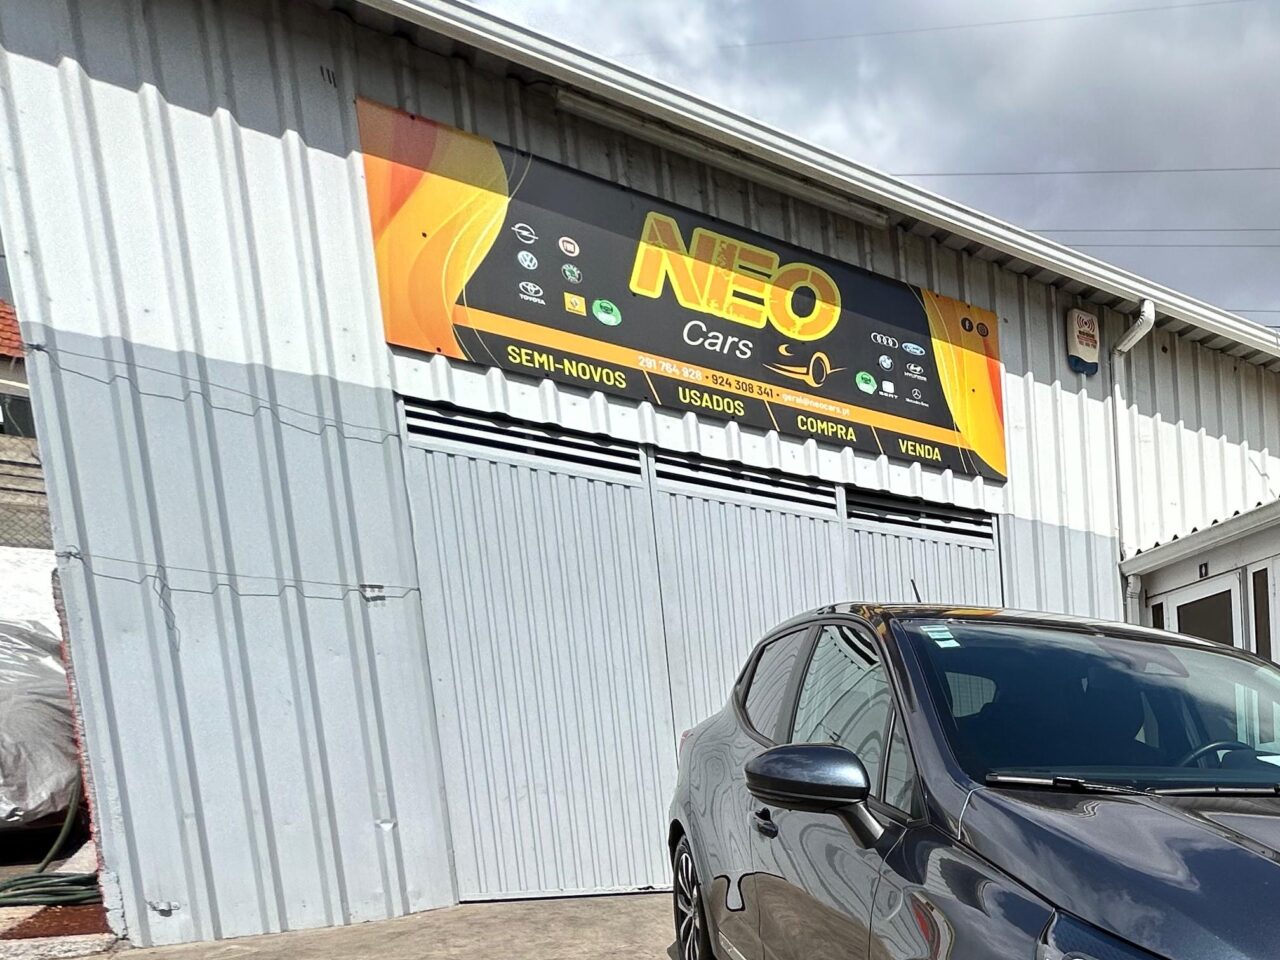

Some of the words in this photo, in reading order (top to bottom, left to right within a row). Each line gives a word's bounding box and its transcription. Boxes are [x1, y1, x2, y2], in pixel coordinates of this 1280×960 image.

[629, 211, 841, 341] NEO
[519, 293, 546, 306] TOYOTA
[683, 320, 754, 359] Cars
[507, 345, 627, 389] SEMI-NOVOS
[678, 386, 745, 416] USADOS
[797, 415, 857, 442] COMPRA
[898, 438, 942, 462] VENDA
[711, 374, 732, 389] 924
[735, 380, 754, 393] 308
[757, 385, 773, 398] 341
